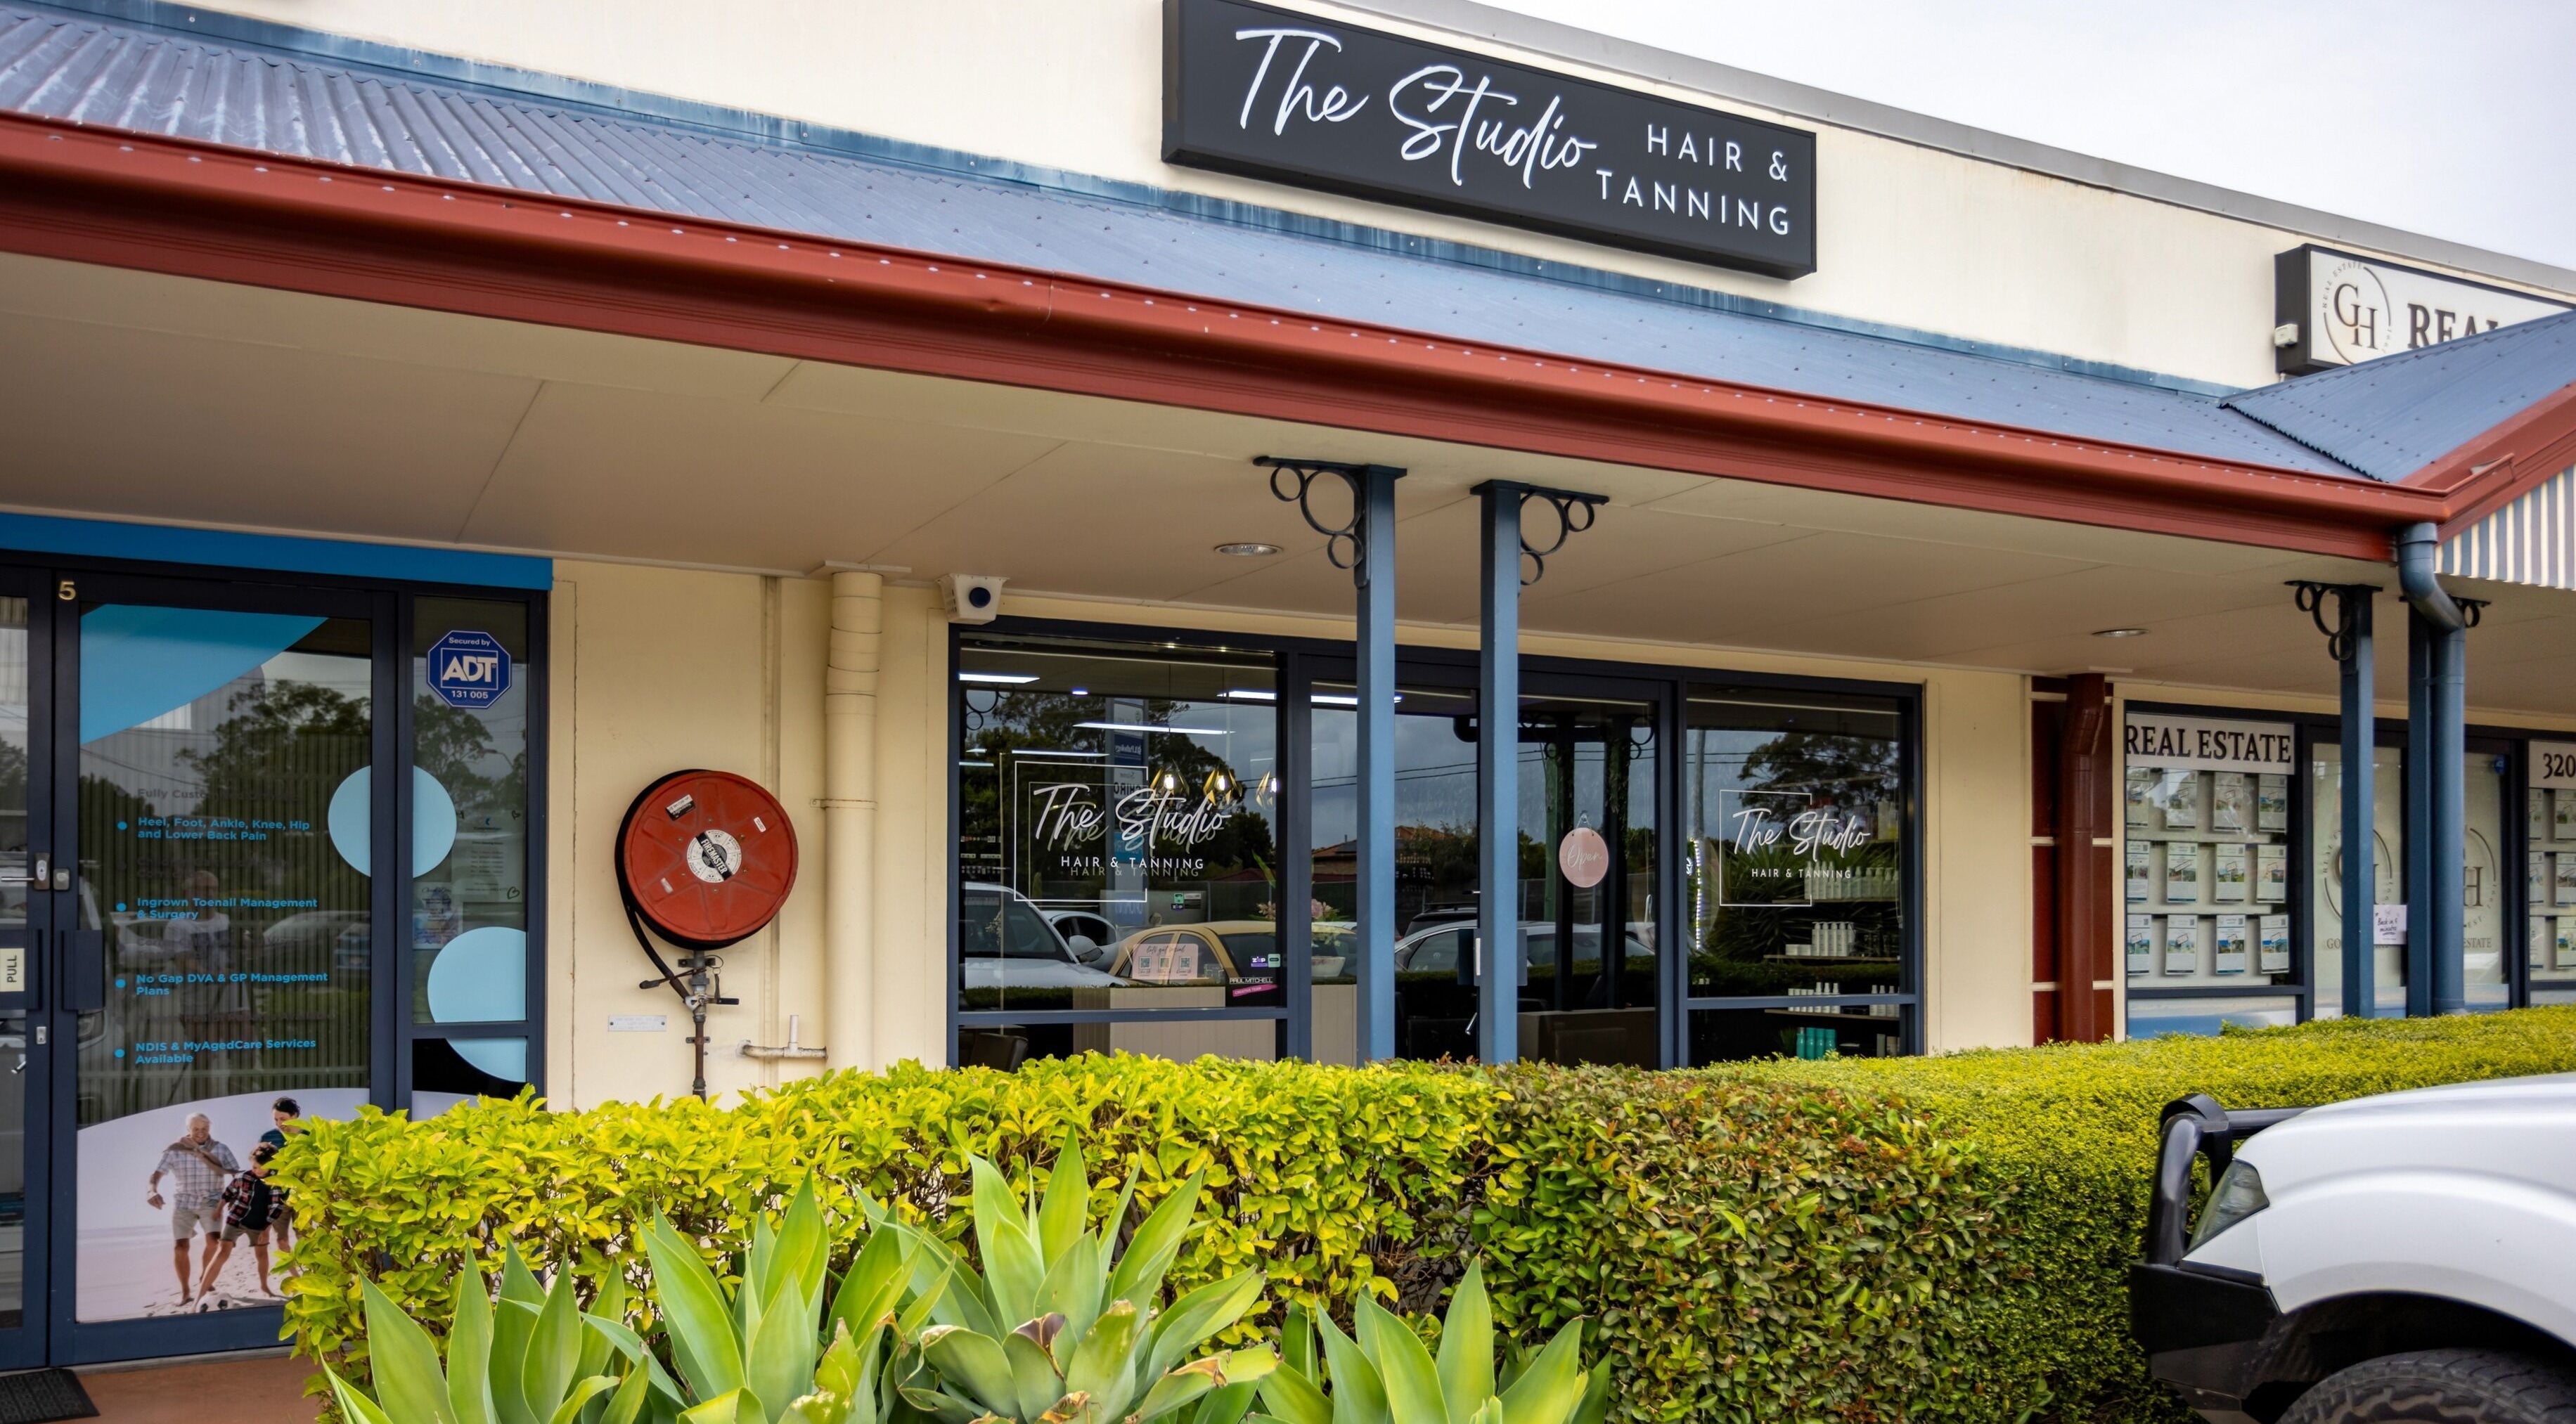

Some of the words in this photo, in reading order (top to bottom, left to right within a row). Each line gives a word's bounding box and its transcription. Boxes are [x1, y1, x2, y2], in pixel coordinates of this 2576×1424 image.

[1235, 28, 1370, 136] The
[1389, 64, 1597, 190] Studio
[1647, 123, 1742, 173] HAIR
[1768, 150, 1790, 181] &
[1596, 169, 1790, 236] TANNING
[2333, 283, 2379, 350] GH
[59, 581, 76, 600] 5
[449, 637, 480, 645] Secured
[442, 655, 498, 682] ADT
[2126, 725, 2191, 758] REAL
[2196, 729, 2291, 763] ESTATE
[2542, 752, 2576, 779] 320
[138, 817, 170, 827] Heel,
[174, 818, 206, 828] Foot,
[210, 820, 248, 829] Ankle,
[252, 820, 286, 830] Knee,
[290, 821, 310, 831] Hip
[1033, 784, 1105, 840] The
[1115, 788, 1232, 849] Studio
[138, 830, 162, 839] and
[165, 831, 203, 840] Lower
[207, 831, 238, 841] Back
[240, 832, 266, 841] Pain
[1732, 808, 1782, 855] The
[1789, 811, 1871, 862] Studio
[700, 839, 728, 874] FIREMASTER
[1061, 855, 1100, 868] HAIR
[1110, 857, 1119, 869] &
[1128, 857, 1204, 870] TANNING
[1567, 843, 1603, 872] Open
[1751, 868, 1779, 878] HAIR
[1785, 868, 1792, 878] &
[1798, 869, 1851, 879] TANNING
[137, 898, 188, 910] Ingrown
[193, 898, 237, 907] Toenail
[240, 898, 318, 910] Management
[137, 910, 146, 919] &
[149, 910, 198, 920] Surgery
[7, 954, 18, 983] PULL
[136, 974, 155, 983] No
[158, 974, 185, 985] Gap
[187, 973, 214, 983] DVA
[217, 973, 226, 983] &
[229, 973, 248, 983] GP
[250, 973, 328, 985] Management
[136, 985, 170, 996] Plans
[135, 1042, 168, 1052] NDIS
[171, 1042, 180, 1051] &
[183, 1040, 262, 1053] MyAgedCare
[266, 1038, 316, 1049] Services
[135, 1054, 194, 1064] Available
